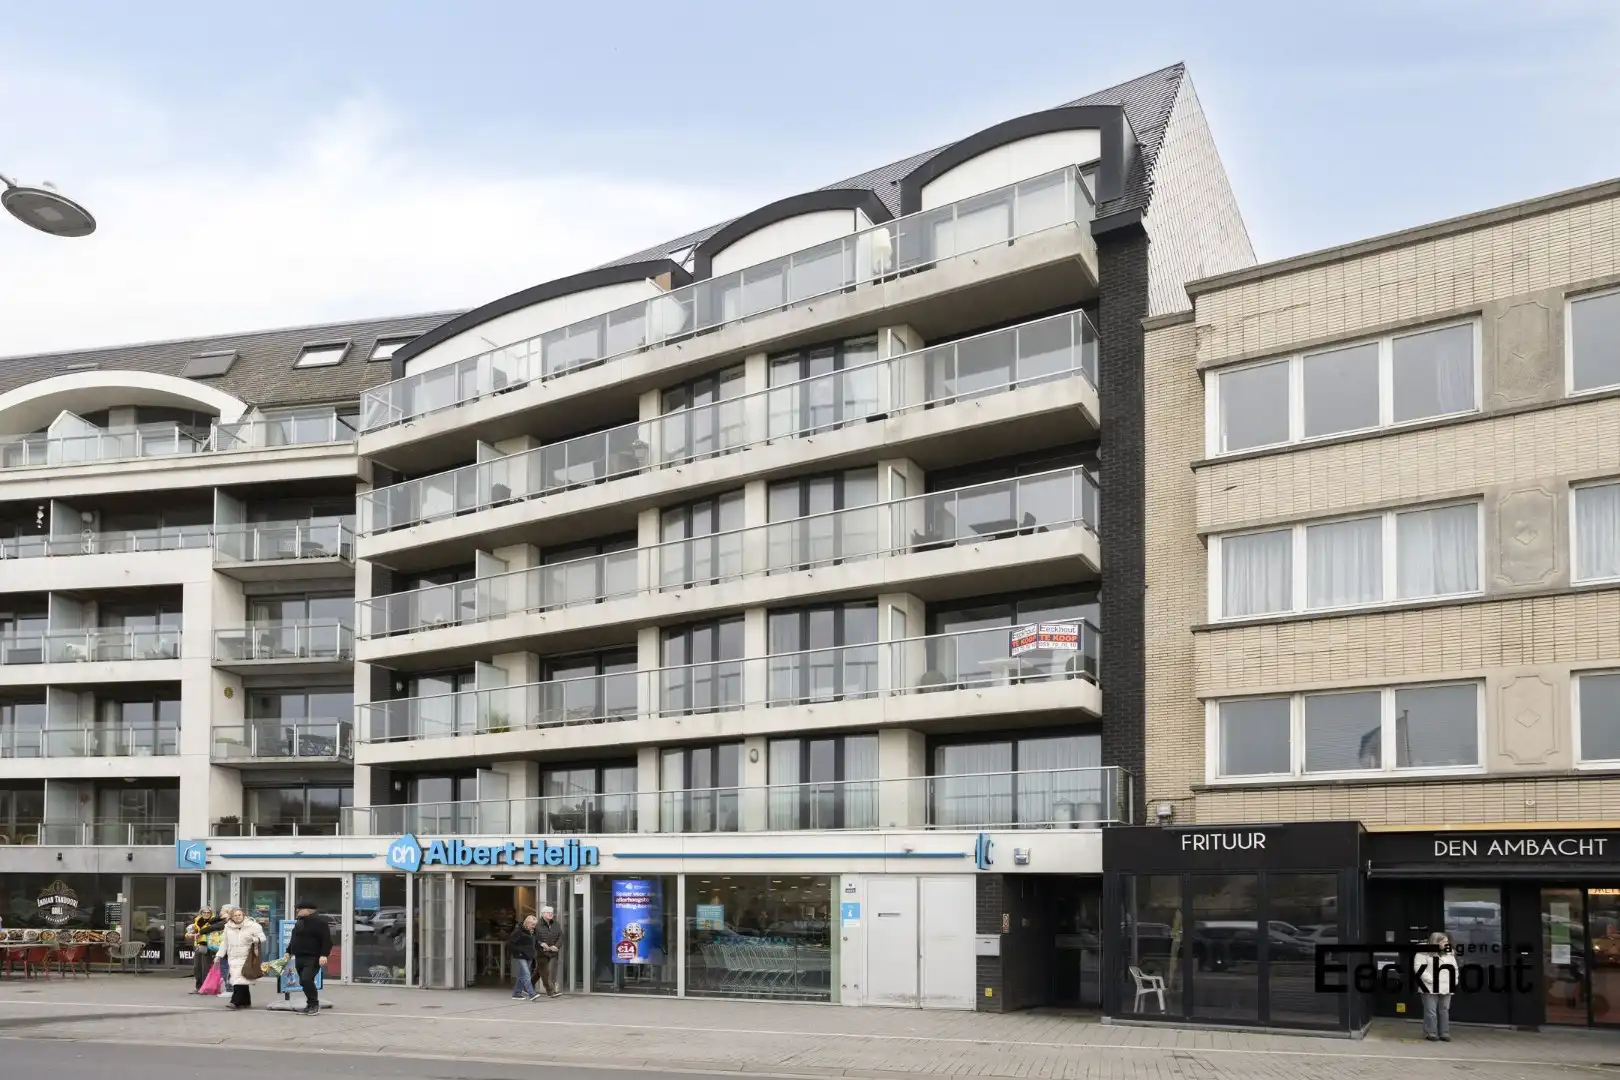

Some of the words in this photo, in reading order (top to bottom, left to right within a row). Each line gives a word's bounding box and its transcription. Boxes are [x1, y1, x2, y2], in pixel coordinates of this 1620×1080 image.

[1040, 624, 1076, 633] Eeckhout
[1021, 634, 1037, 645] KOOP
[1181, 832, 1266, 851] FRITUUR
[1434, 840, 1477, 856] DEN
[1487, 838, 1608, 856] AMBACHT
[424, 839, 517, 866] Albert
[524, 838, 600, 872] Heijn
[617, 945, 635, 953] €14
